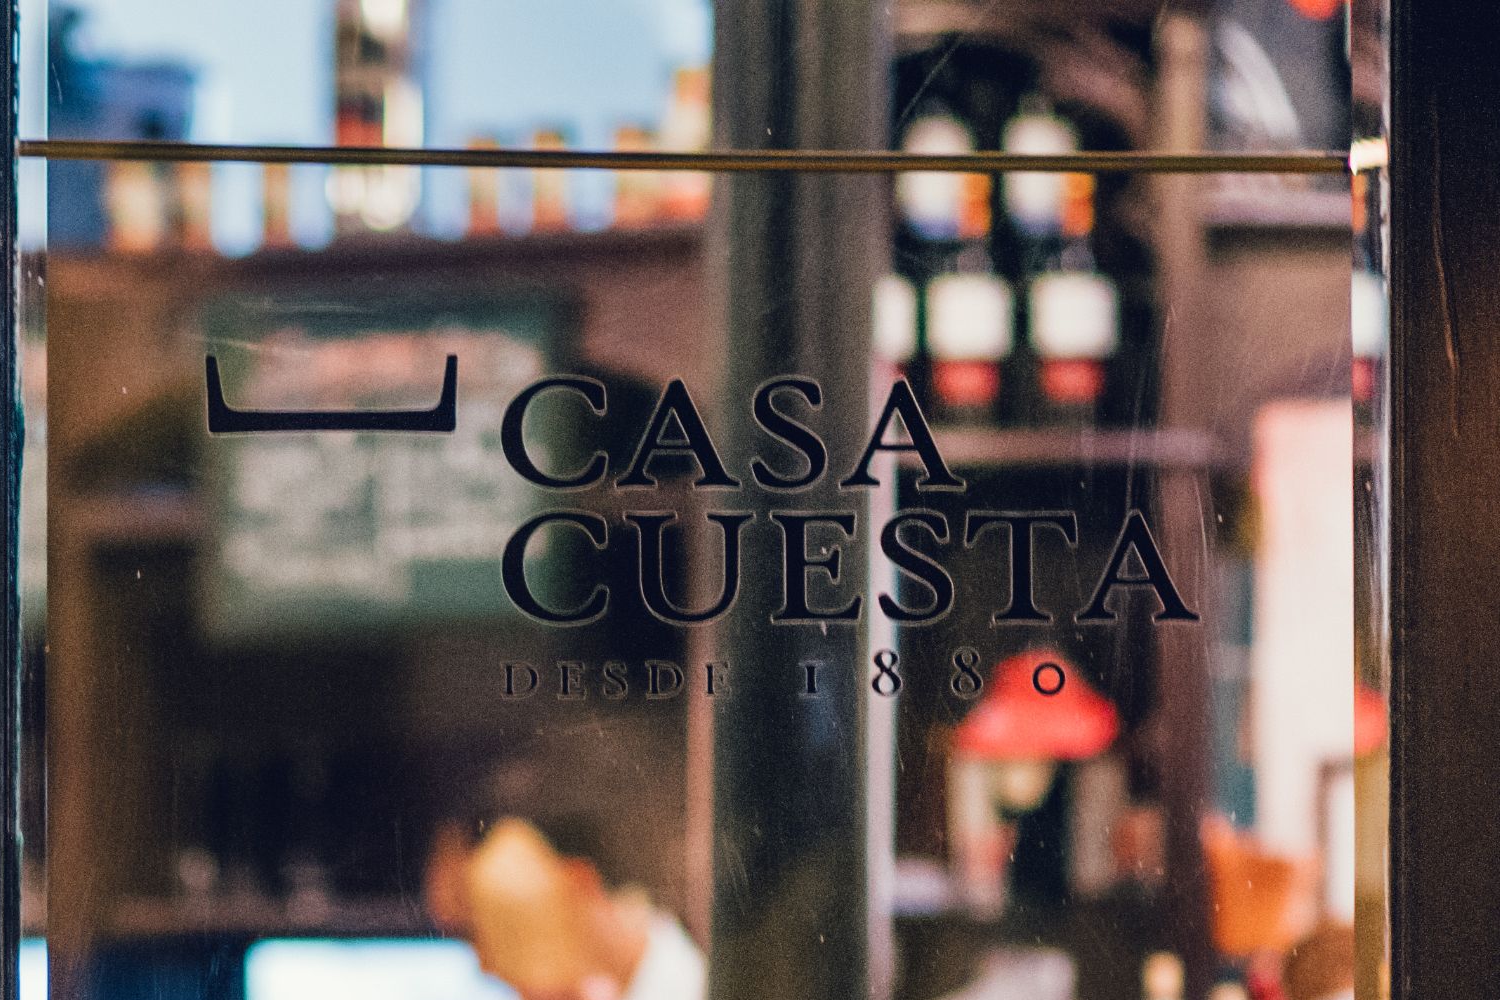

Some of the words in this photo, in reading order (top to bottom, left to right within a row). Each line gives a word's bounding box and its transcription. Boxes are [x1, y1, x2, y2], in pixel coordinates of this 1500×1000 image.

[500, 376, 966, 491] CASA
[501, 509, 1199, 627] CUESTA
[504, 661, 731, 699] DESDE
[801, 647, 1066, 699] 1880
